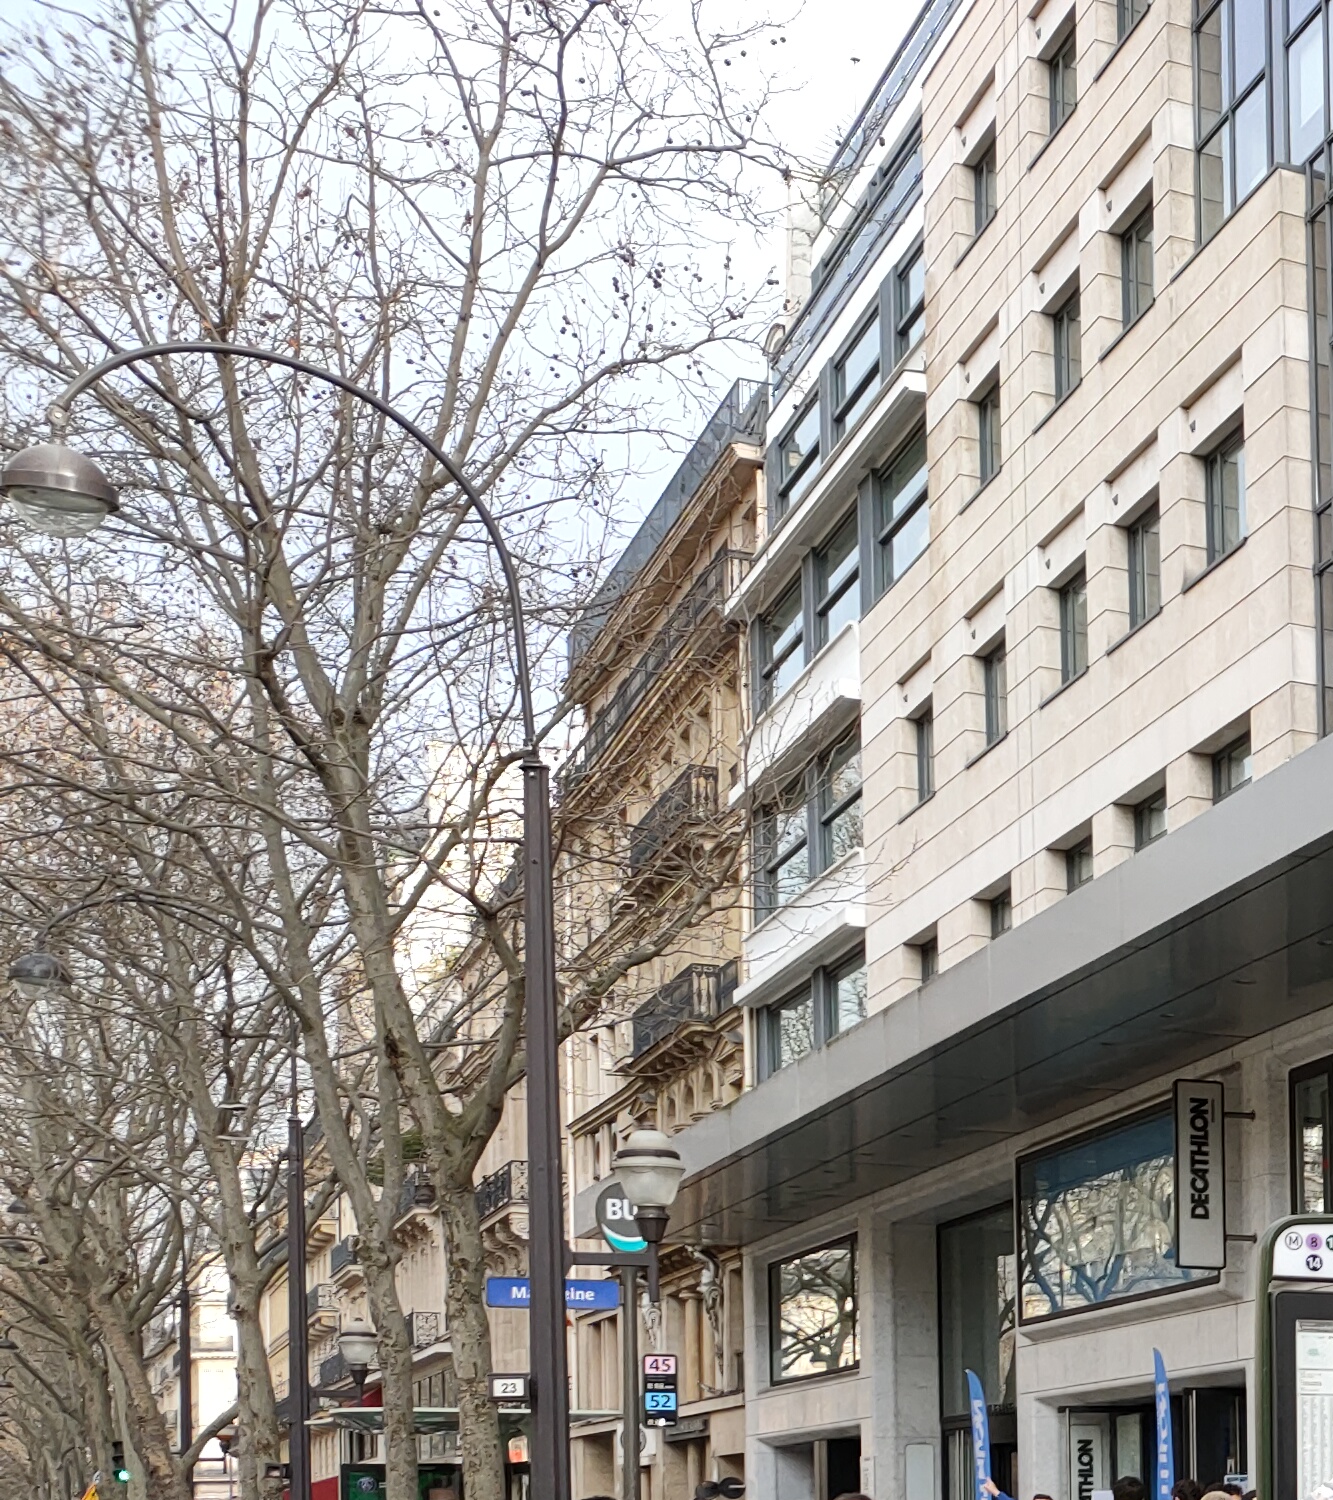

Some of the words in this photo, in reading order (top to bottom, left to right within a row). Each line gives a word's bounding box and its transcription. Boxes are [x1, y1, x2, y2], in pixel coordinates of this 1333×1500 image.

[1189, 1097, 1210, 1220] DECATHLON
[606, 1198, 637, 1220] BU
[1306, 1257, 1321, 1268] 14
[649, 1358, 671, 1372] 45
[501, 1382, 517, 1393] 23
[649, 1394, 671, 1408] 52
